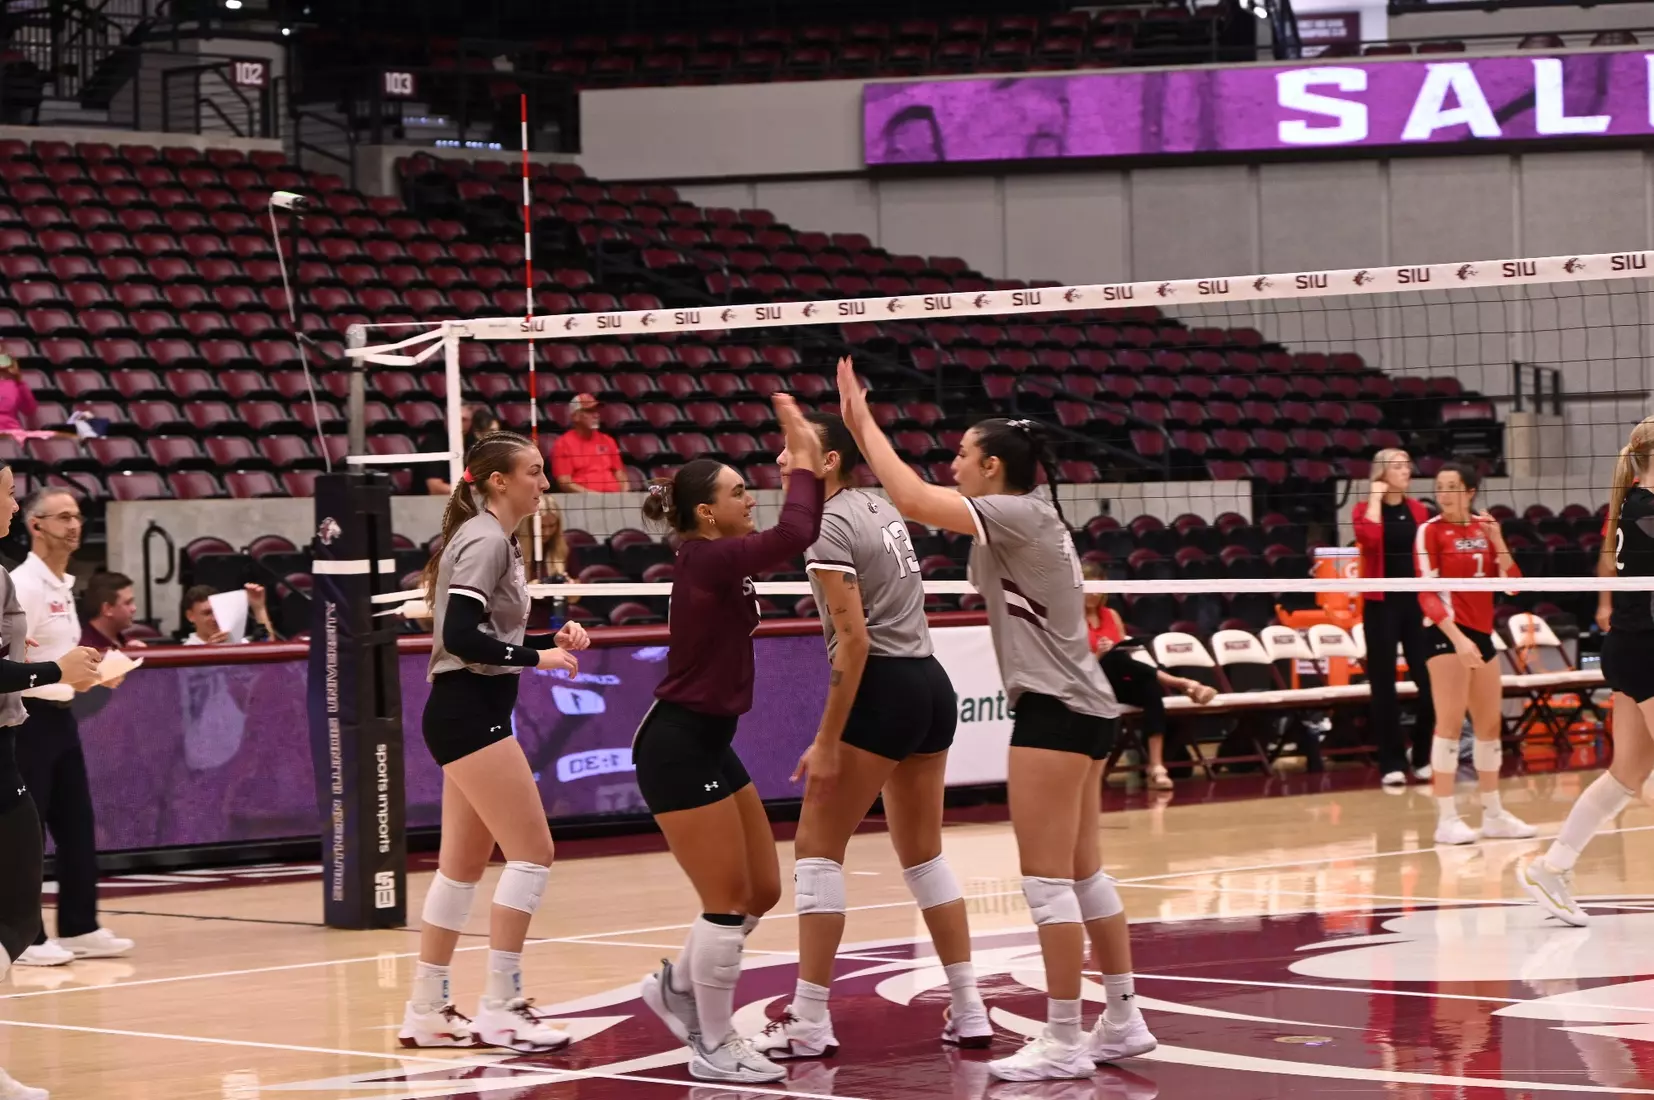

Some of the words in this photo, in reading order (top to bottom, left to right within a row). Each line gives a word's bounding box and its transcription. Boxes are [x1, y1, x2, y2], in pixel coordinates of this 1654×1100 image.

[235, 62, 264, 85] 102
[384, 72, 413, 94] 103
[1275, 54, 1654, 144] SAL
[520, 319, 545, 333] SIU
[597, 315, 621, 329] SIU
[675, 311, 701, 325] SIU
[756, 306, 781, 320] SIU
[838, 302, 865, 316] SIU
[924, 297, 952, 311] SIU
[1012, 291, 1041, 306] SIU
[1103, 286, 1133, 301] SIU
[1198, 280, 1229, 295] SIU
[1295, 274, 1328, 289] SIU
[1397, 268, 1430, 284] SIU
[1502, 261, 1536, 278] SIU
[1611, 254, 1646, 271] SIU
[881, 520, 920, 579] 13
[1472, 553, 1486, 578] 1
[325, 601, 339, 713] UNIVERSITY
[374, 744, 389, 789] sports
[376, 791, 391, 853] imports
